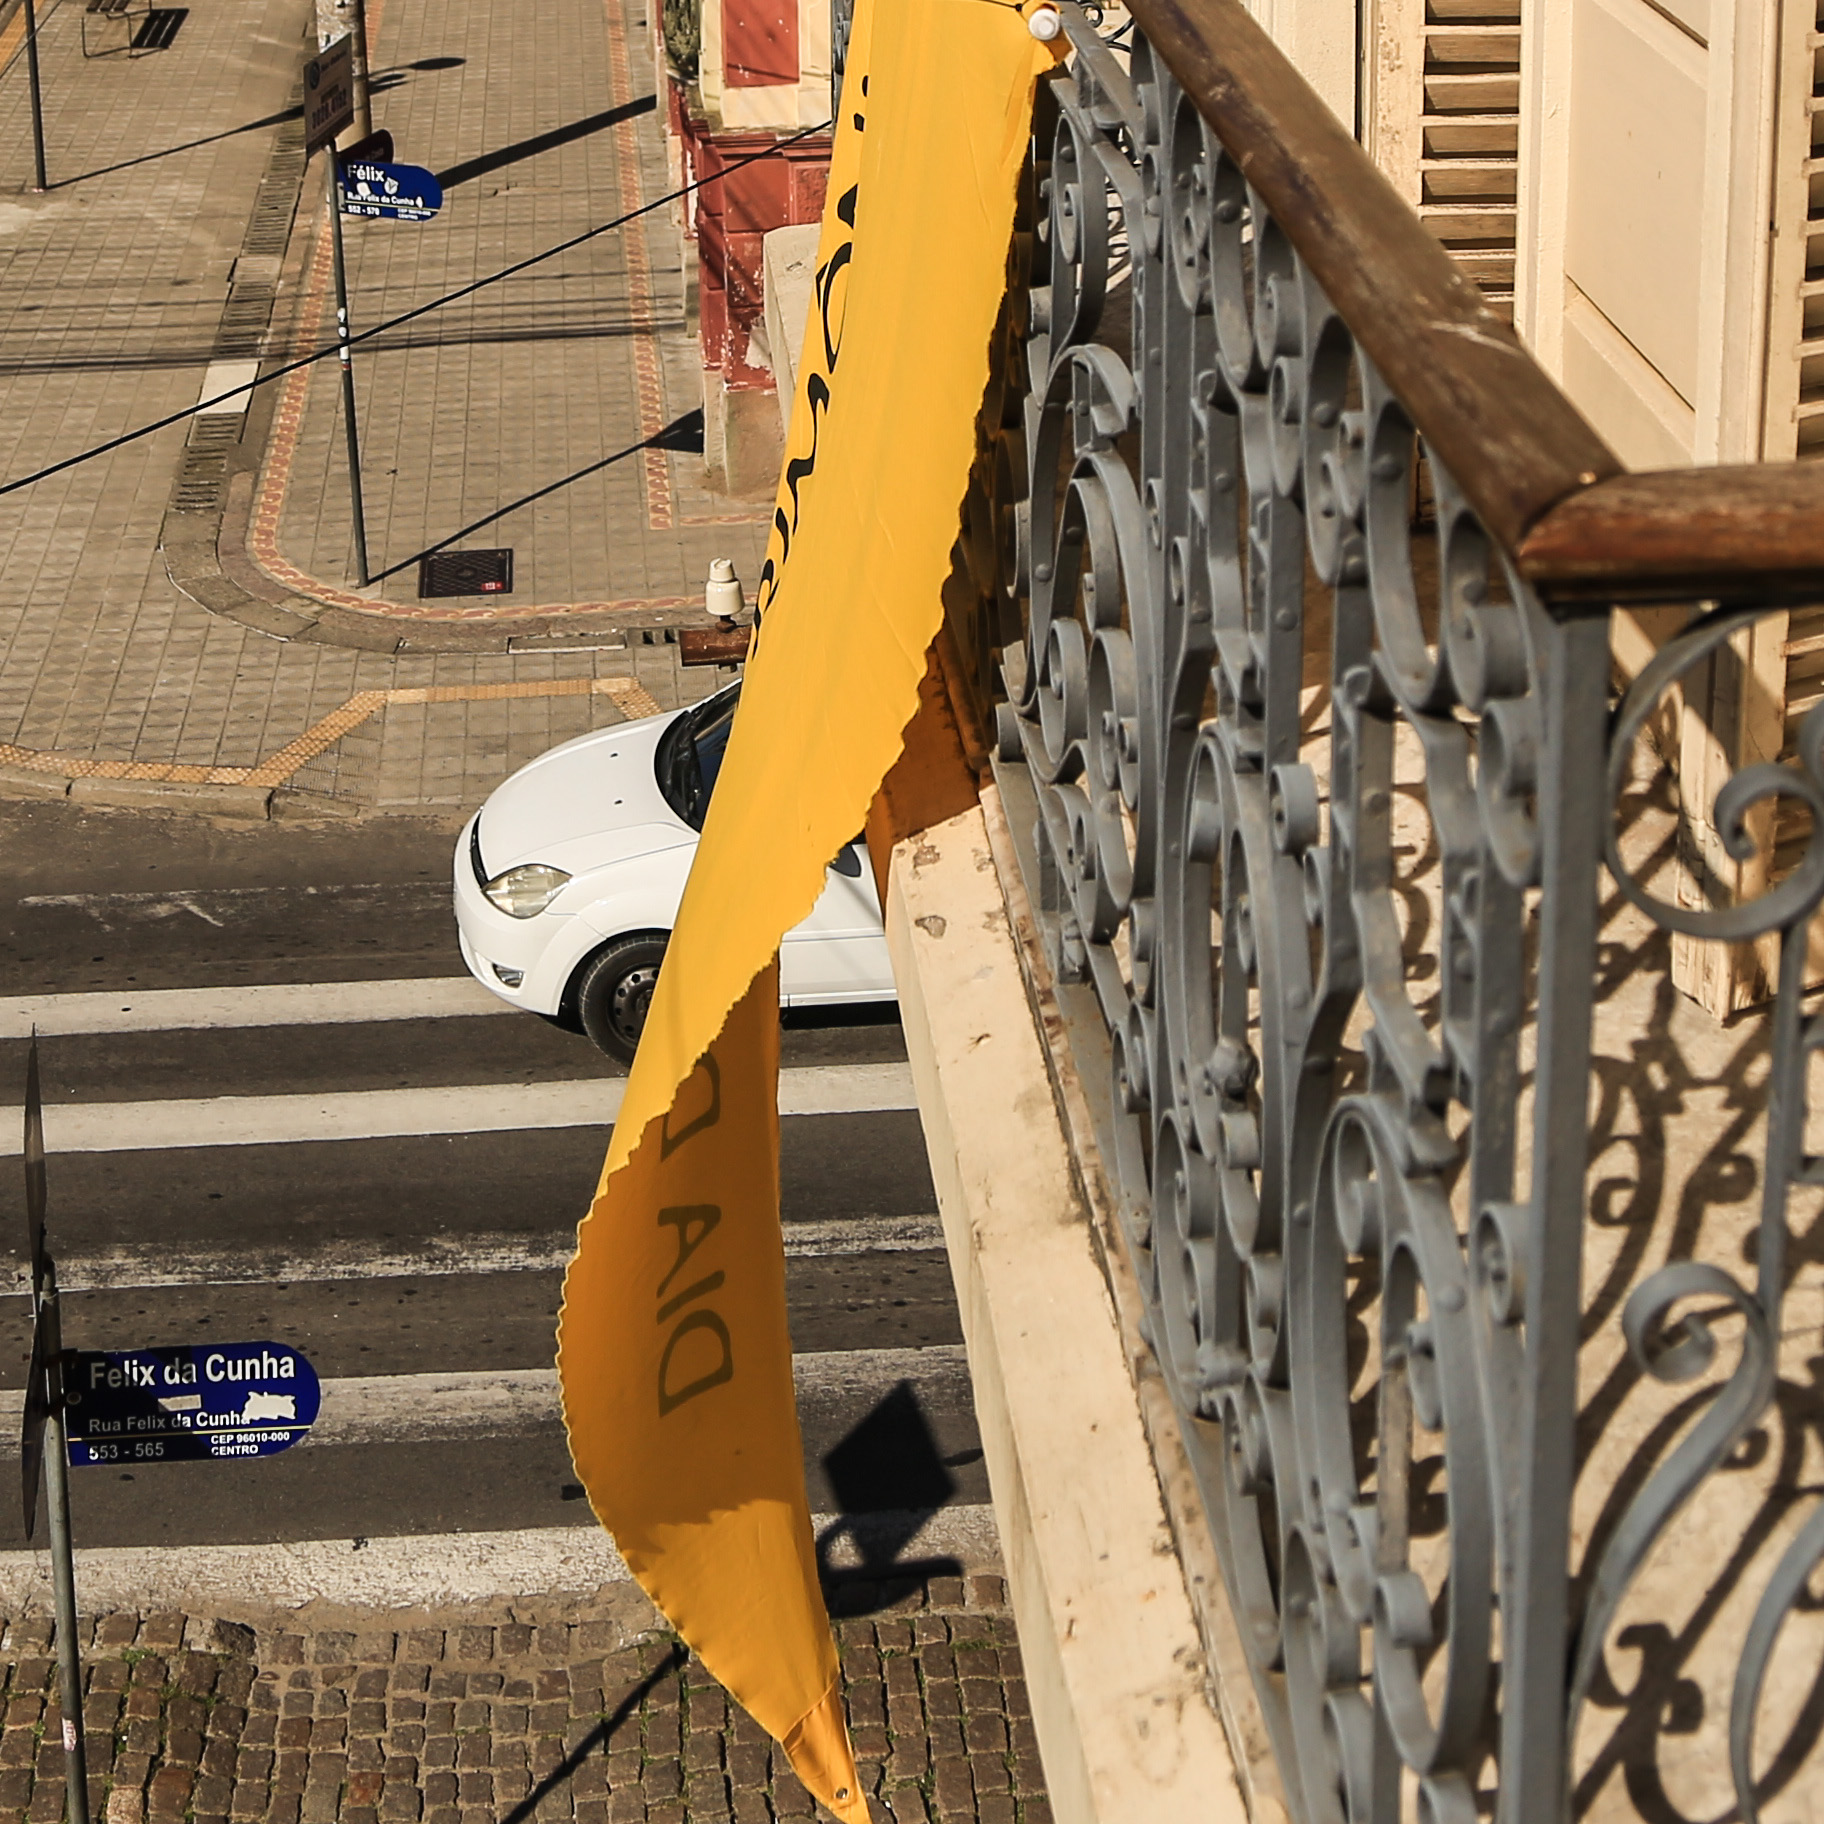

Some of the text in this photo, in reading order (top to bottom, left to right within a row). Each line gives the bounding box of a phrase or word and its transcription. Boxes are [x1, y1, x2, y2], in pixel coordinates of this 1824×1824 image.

[347, 164, 385, 182] Félix
[347, 191, 361, 201] Rua
[381, 195, 390, 203] da
[391, 195, 414, 206] Cunha
[90, 1351, 296, 1389] Felix da Cunha
[89, 1410, 251, 1433] Rua Felix da Cunha
[210, 1431, 290, 1445] CEP 96010-000
[88, 1443, 118, 1461] 553
[134, 1442, 165, 1458] 565
[211, 1444, 259, 1456] CENTRO
